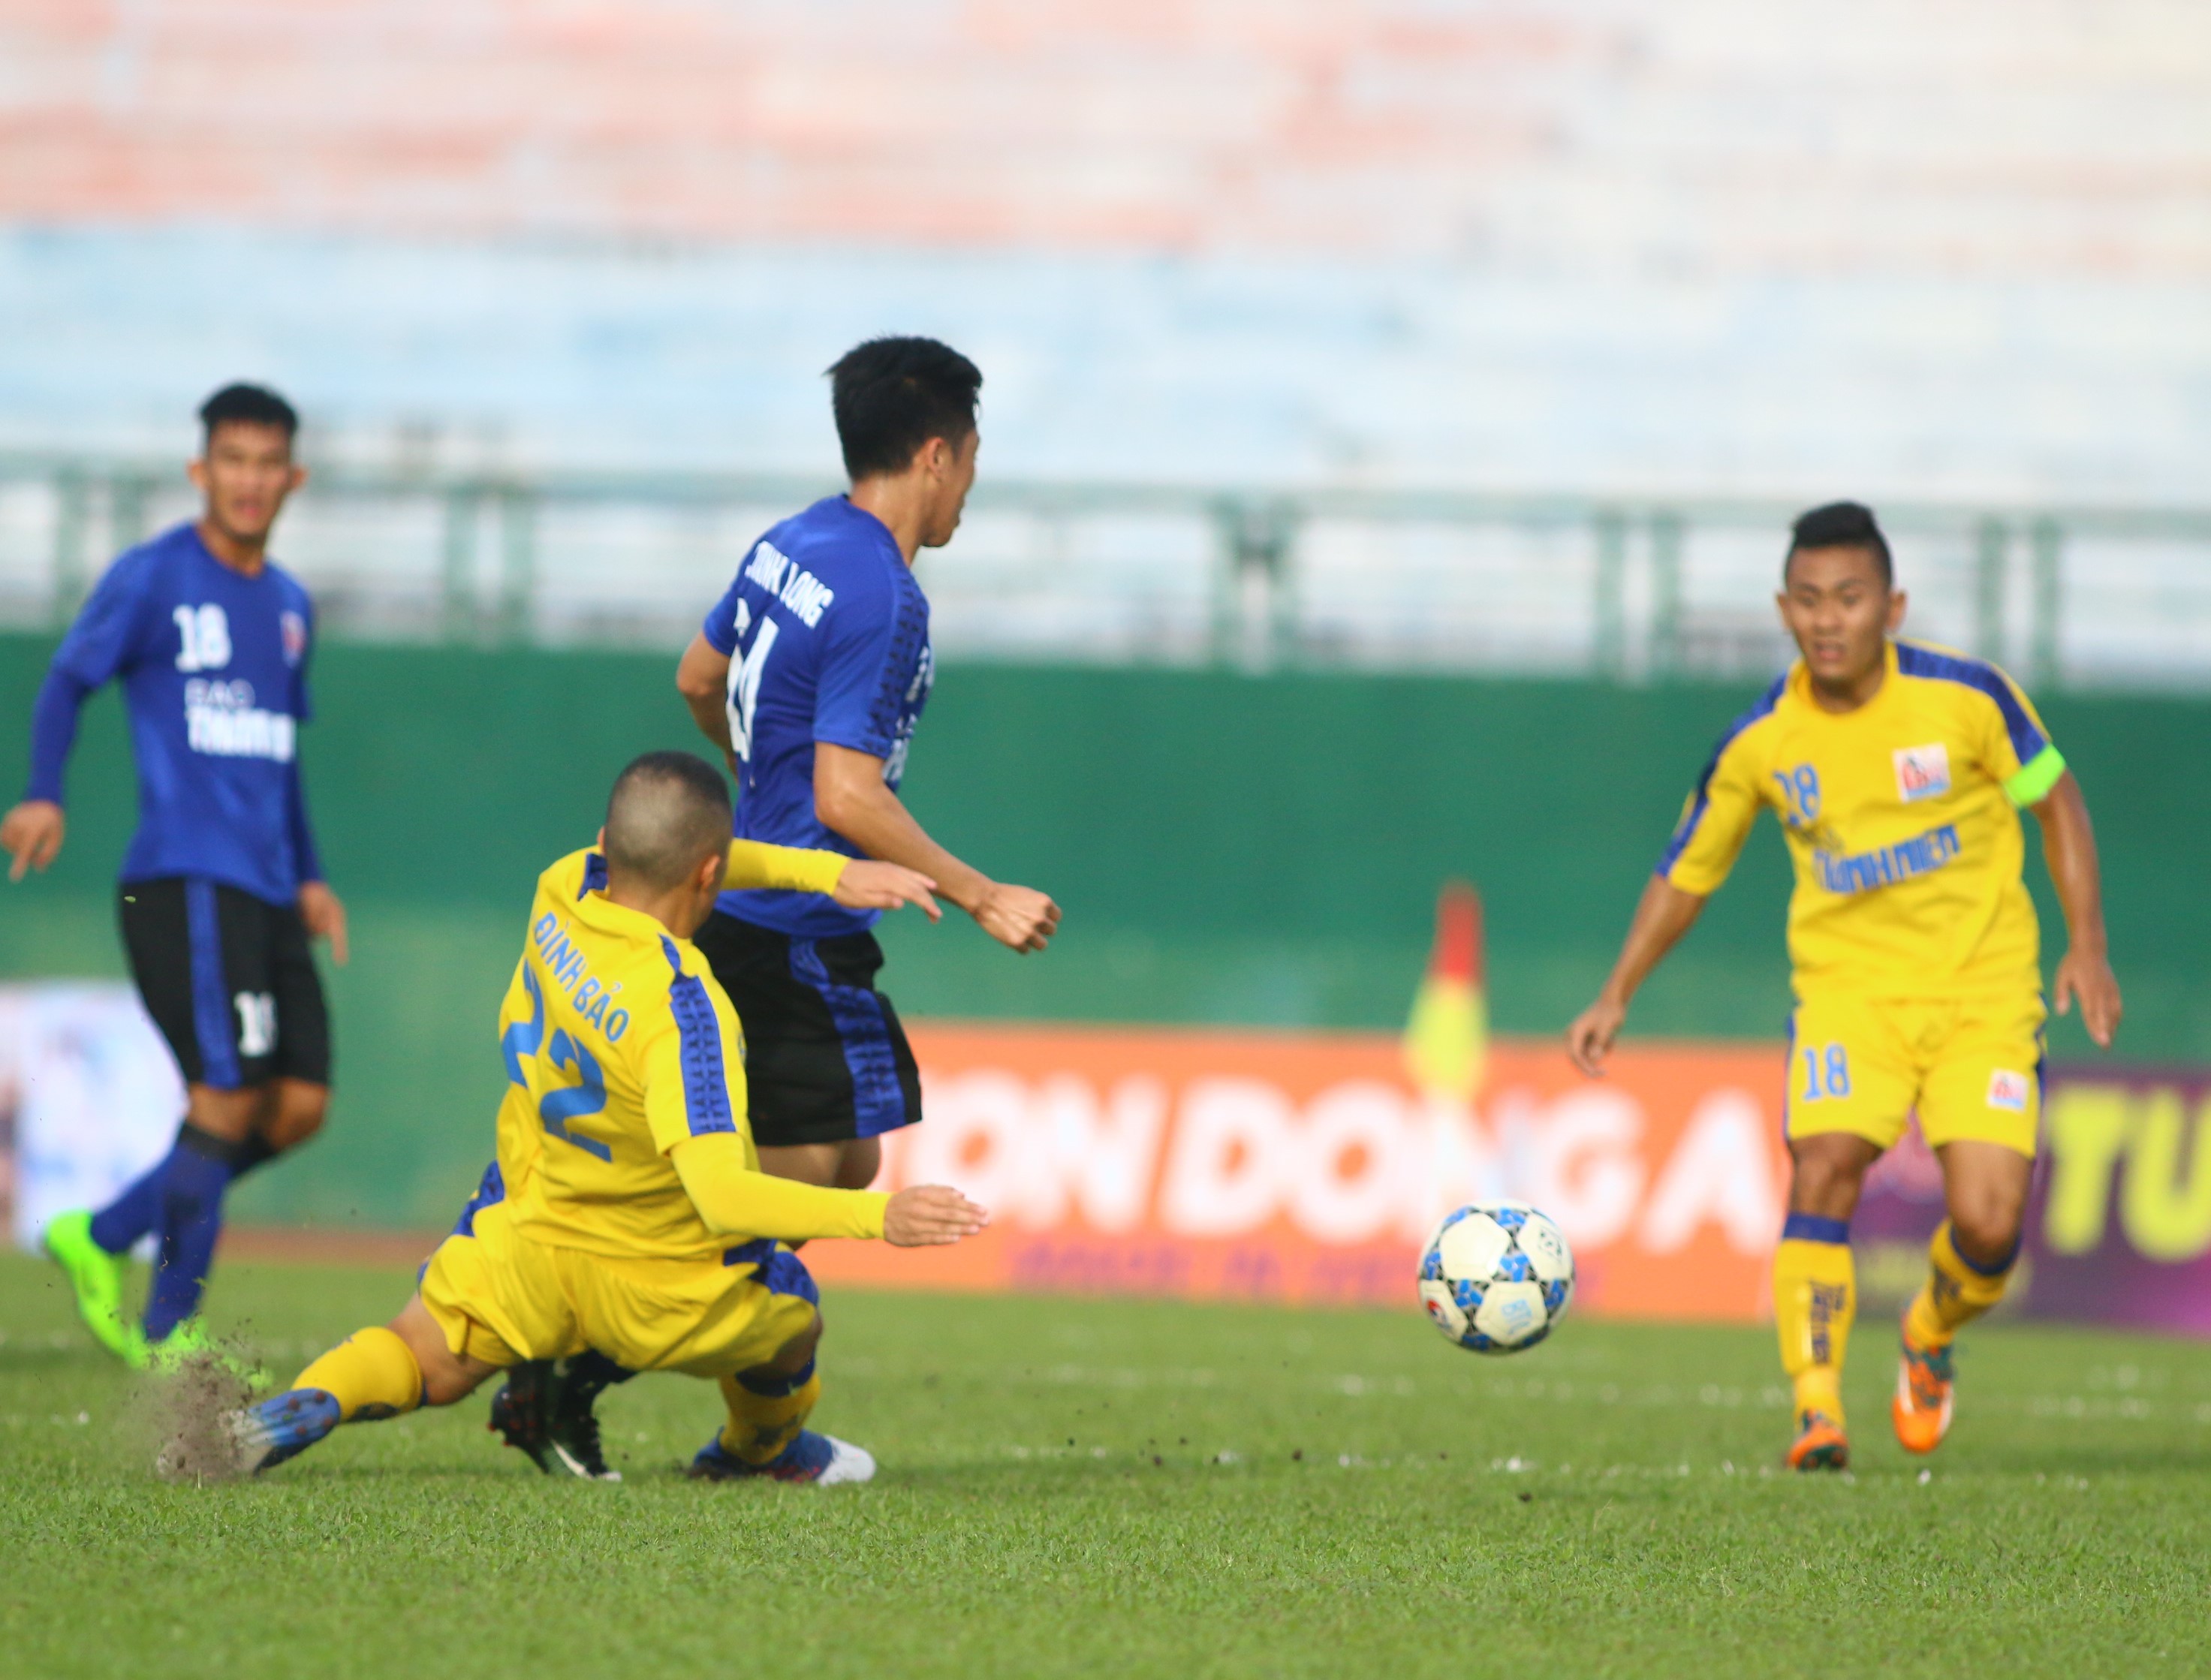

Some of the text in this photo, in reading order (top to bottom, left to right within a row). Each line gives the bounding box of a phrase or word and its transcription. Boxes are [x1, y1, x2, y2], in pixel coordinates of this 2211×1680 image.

[779, 562, 834, 629] LONG
[572, 976, 629, 1042] BẢO
[501, 956, 613, 1163] 22
[1803, 1043, 1850, 1100] 18
